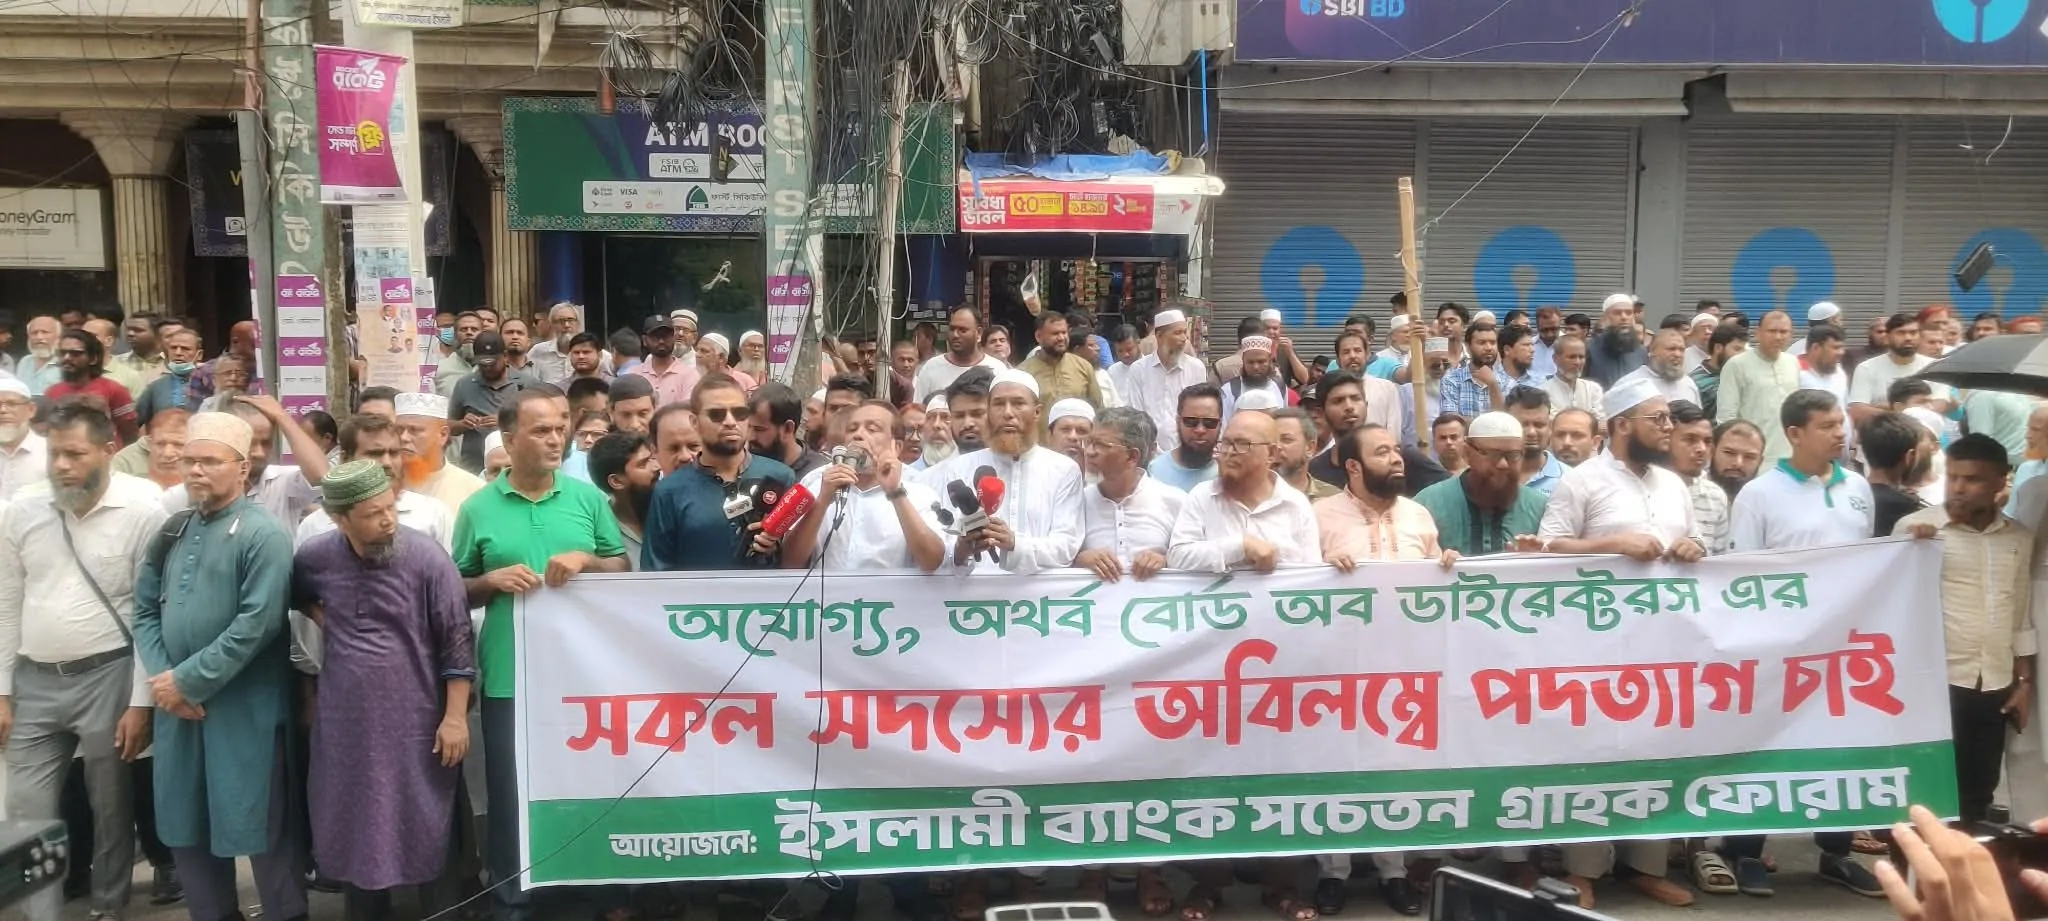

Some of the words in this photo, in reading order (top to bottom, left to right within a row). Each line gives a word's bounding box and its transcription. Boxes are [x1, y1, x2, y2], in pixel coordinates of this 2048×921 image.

[645, 121, 709, 147] ATM
[0, 209, 76, 226] oneyGram
[619, 188, 638, 196] VISA
[663, 598, 920, 657] অযোগ্য,
[944, 581, 1102, 639] অথর্ব
[1120, 575, 1252, 648] বোর্ড
[1270, 587, 1379, 627] অব
[1395, 568, 1701, 634] ডাইরেক্টরস
[1721, 572, 1809, 611] এর
[561, 691, 778, 756] সকল
[805, 684, 1106, 754] সদস্যের
[1132, 638, 1444, 751] অবিলম্বে
[1470, 658, 1759, 729] পদত্যাগ
[1782, 628, 1906, 718] চাই
[608, 830, 758, 862] আয়োজনে:
[774, 788, 1031, 862] ইসলামী
[1040, 797, 1240, 845] ব্যাংক
[1245, 790, 1476, 837] সচেতন
[1497, 779, 1674, 830] গ্রাহক
[1684, 767, 1911, 821] ফোরাম
